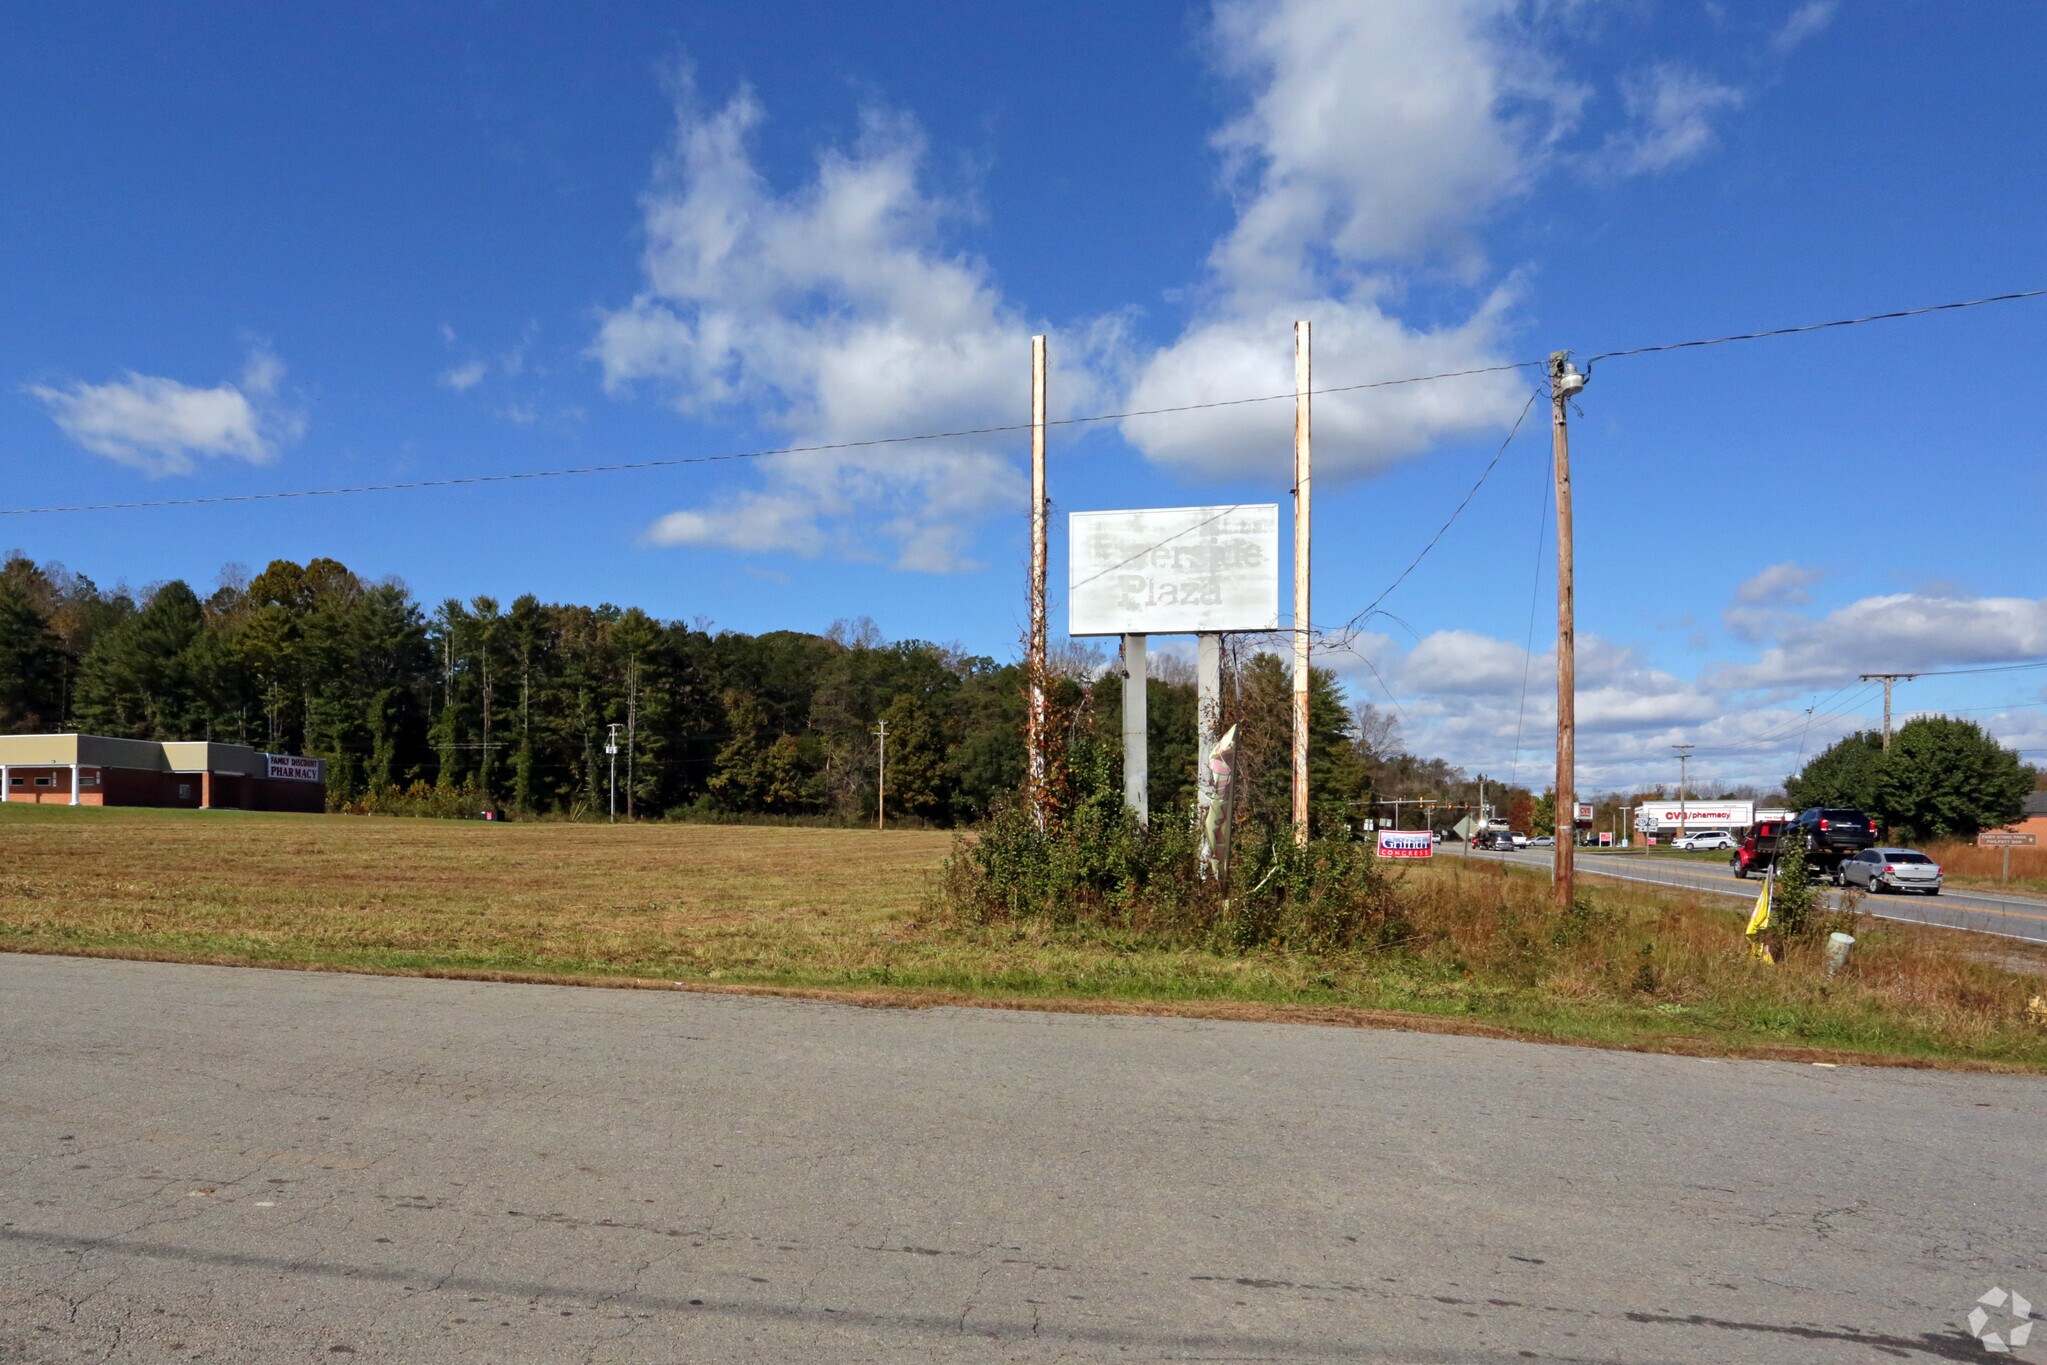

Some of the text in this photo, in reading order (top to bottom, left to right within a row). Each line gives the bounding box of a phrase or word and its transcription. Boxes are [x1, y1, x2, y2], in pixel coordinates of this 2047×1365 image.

[1116, 574, 1223, 607] Plaza
[270, 756, 317, 767] FAMILY DISCOUNT
[270, 766, 317, 778] PHARMACY
[1382, 837, 1428, 849] Griffith
